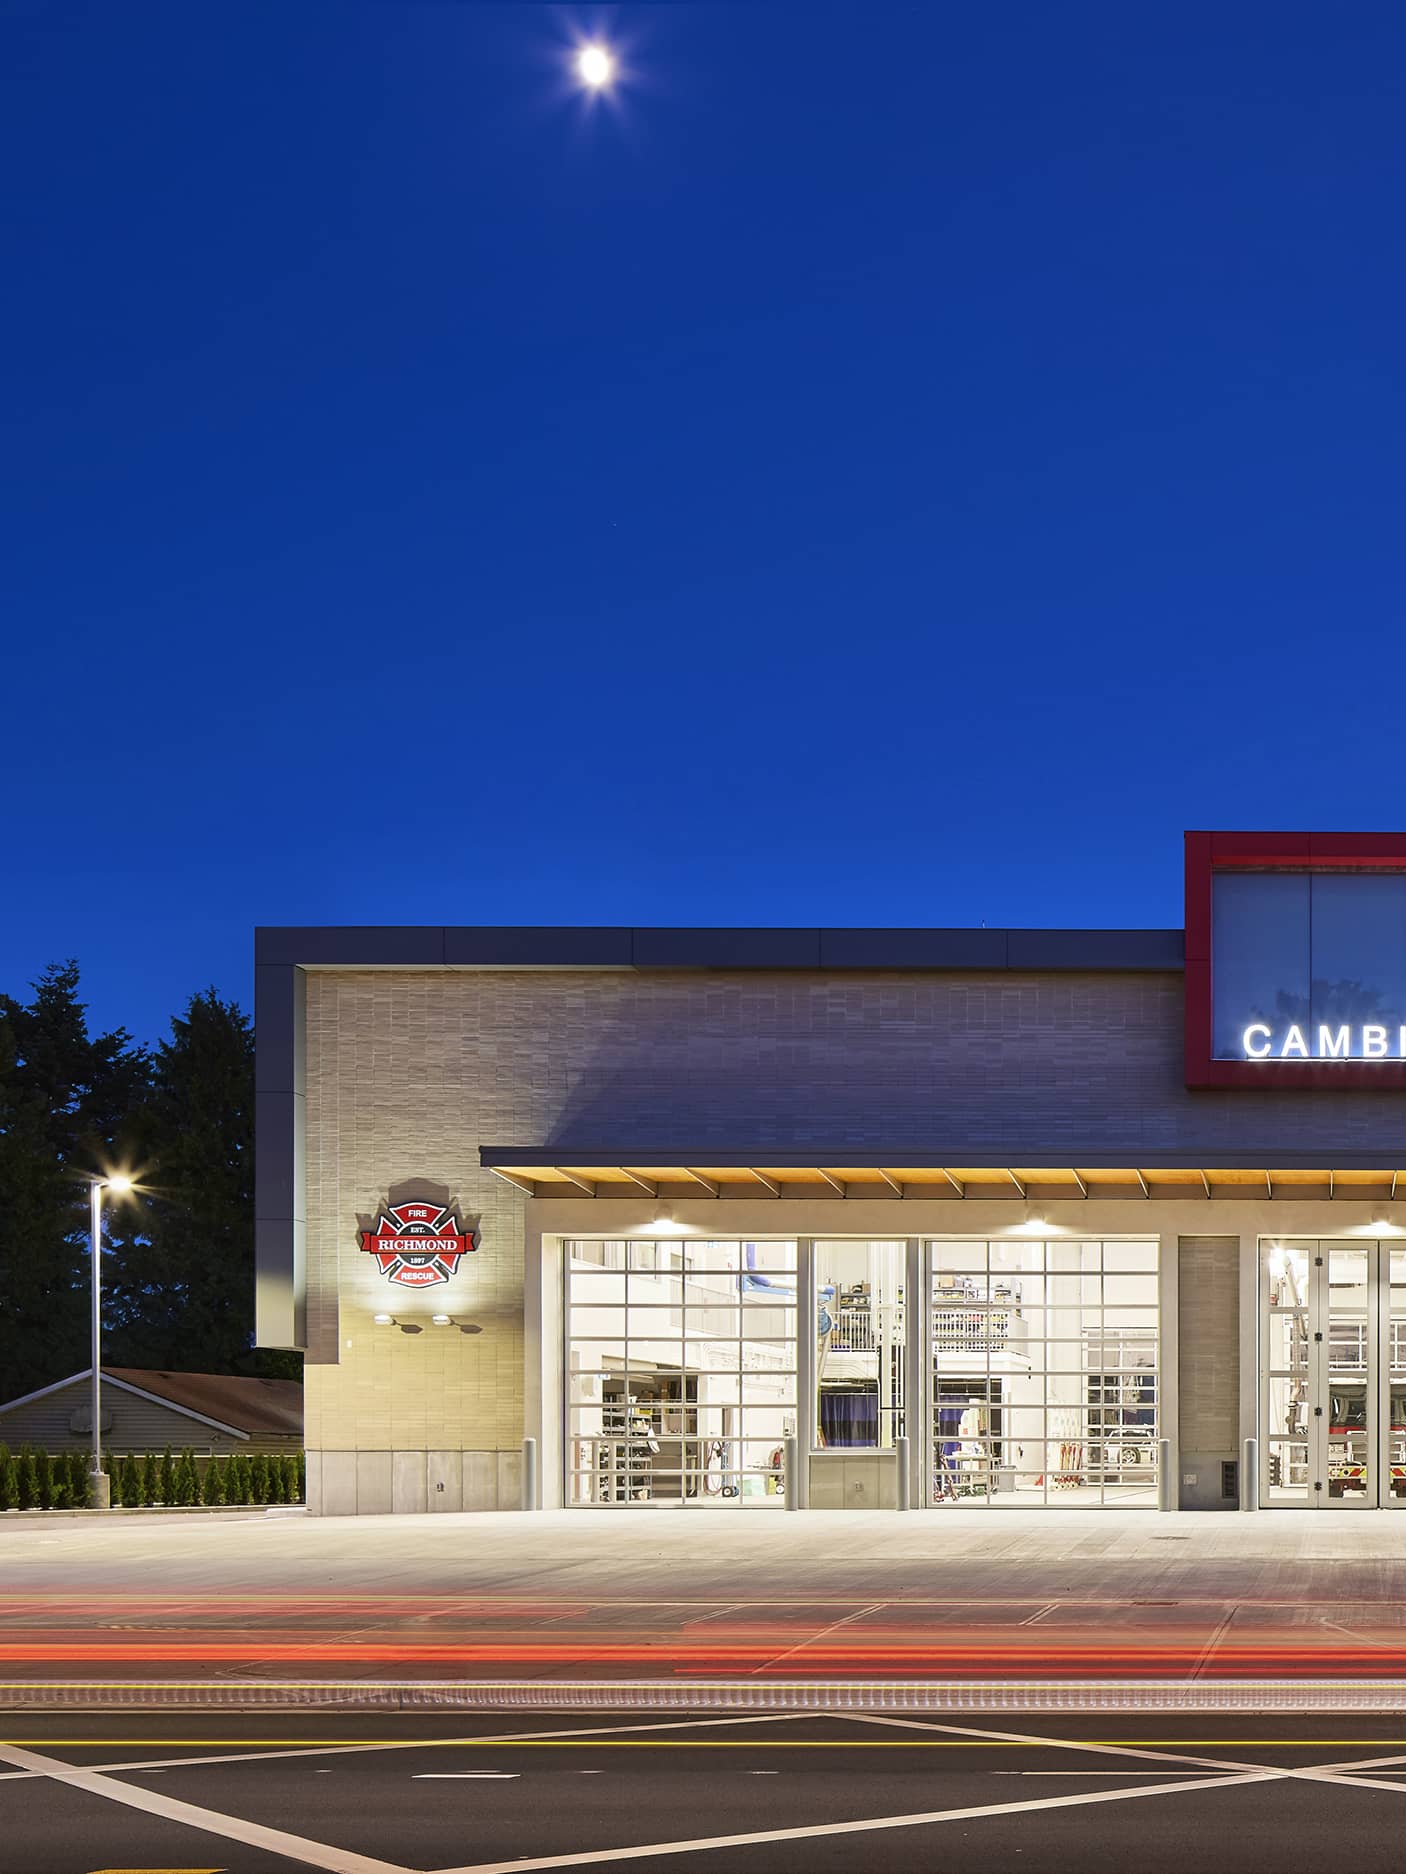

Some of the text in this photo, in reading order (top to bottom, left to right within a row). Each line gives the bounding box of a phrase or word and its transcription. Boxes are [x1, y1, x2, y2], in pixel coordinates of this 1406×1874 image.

[408, 1209, 427, 1217] FIRE
[377, 1239, 458, 1251] RICHMOND
[400, 1272, 435, 1281] RESCUE
